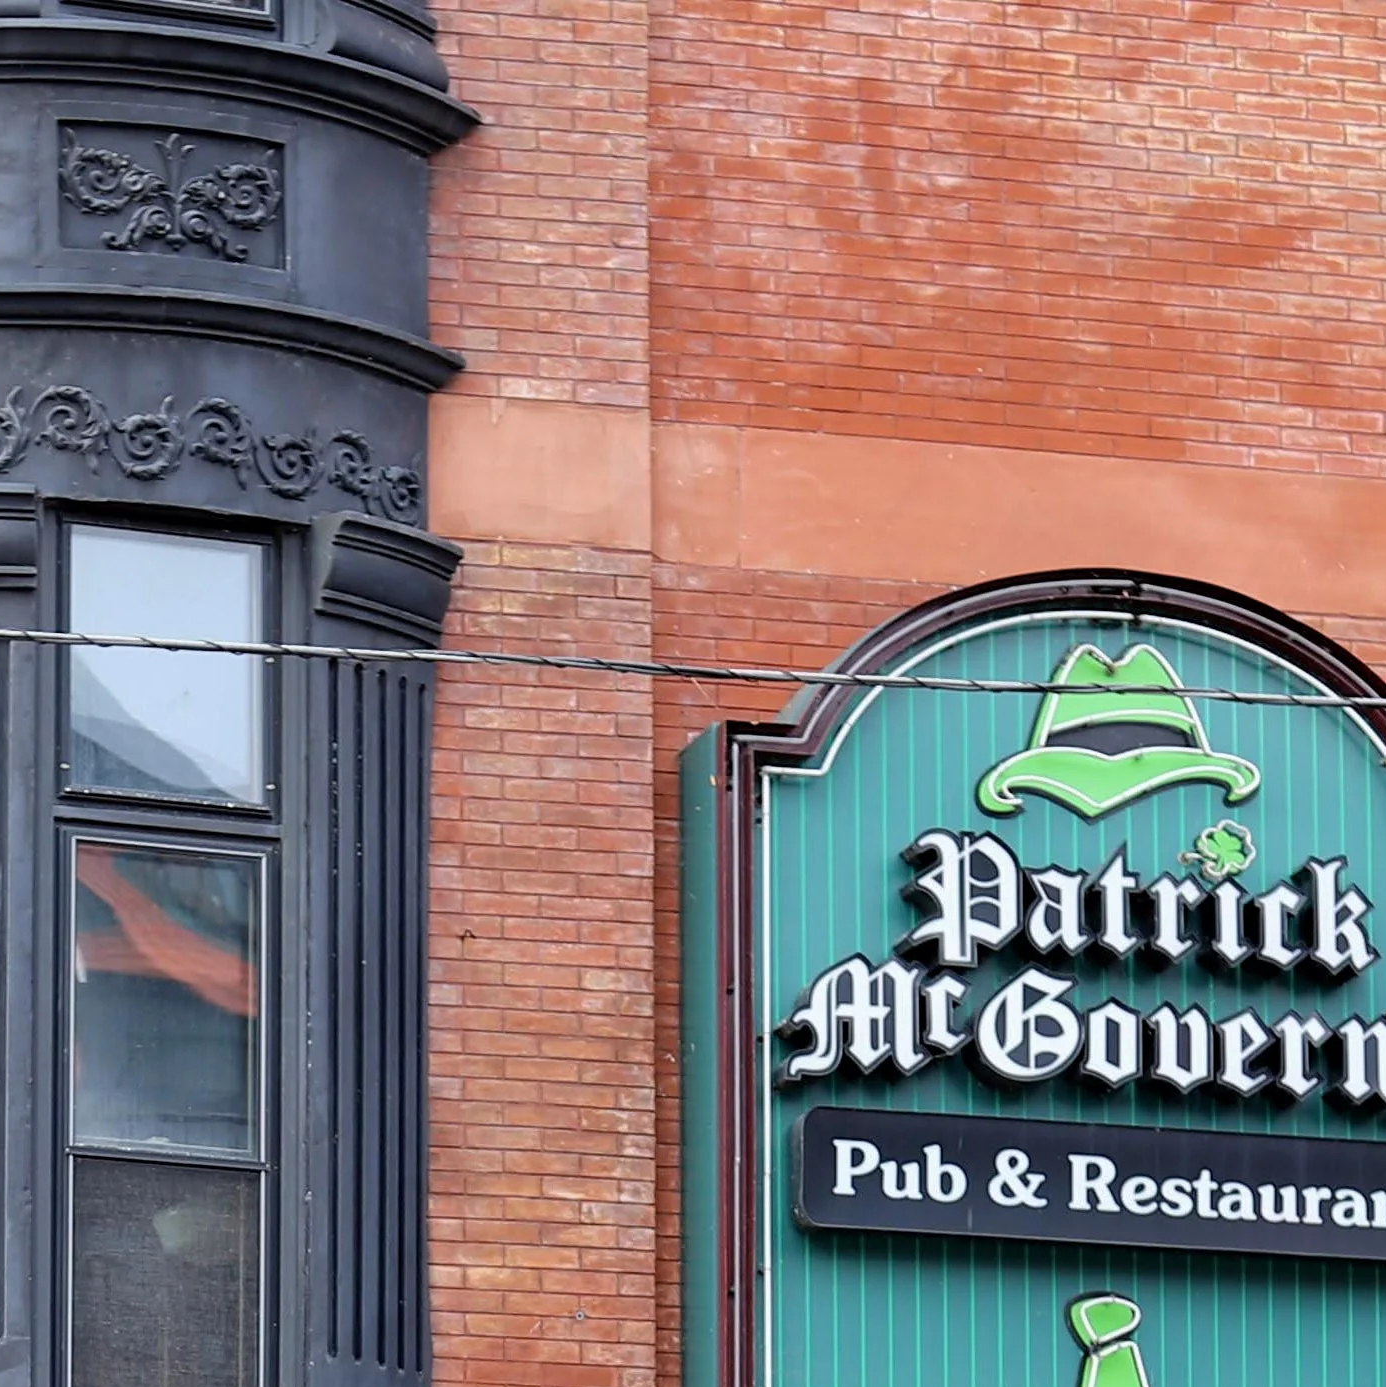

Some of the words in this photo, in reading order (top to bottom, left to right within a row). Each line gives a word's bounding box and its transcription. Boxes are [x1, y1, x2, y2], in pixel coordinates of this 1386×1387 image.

[908, 828, 1380, 974] Patrick
[831, 1137, 970, 1205] Pub
[987, 1147, 1047, 1210] &
